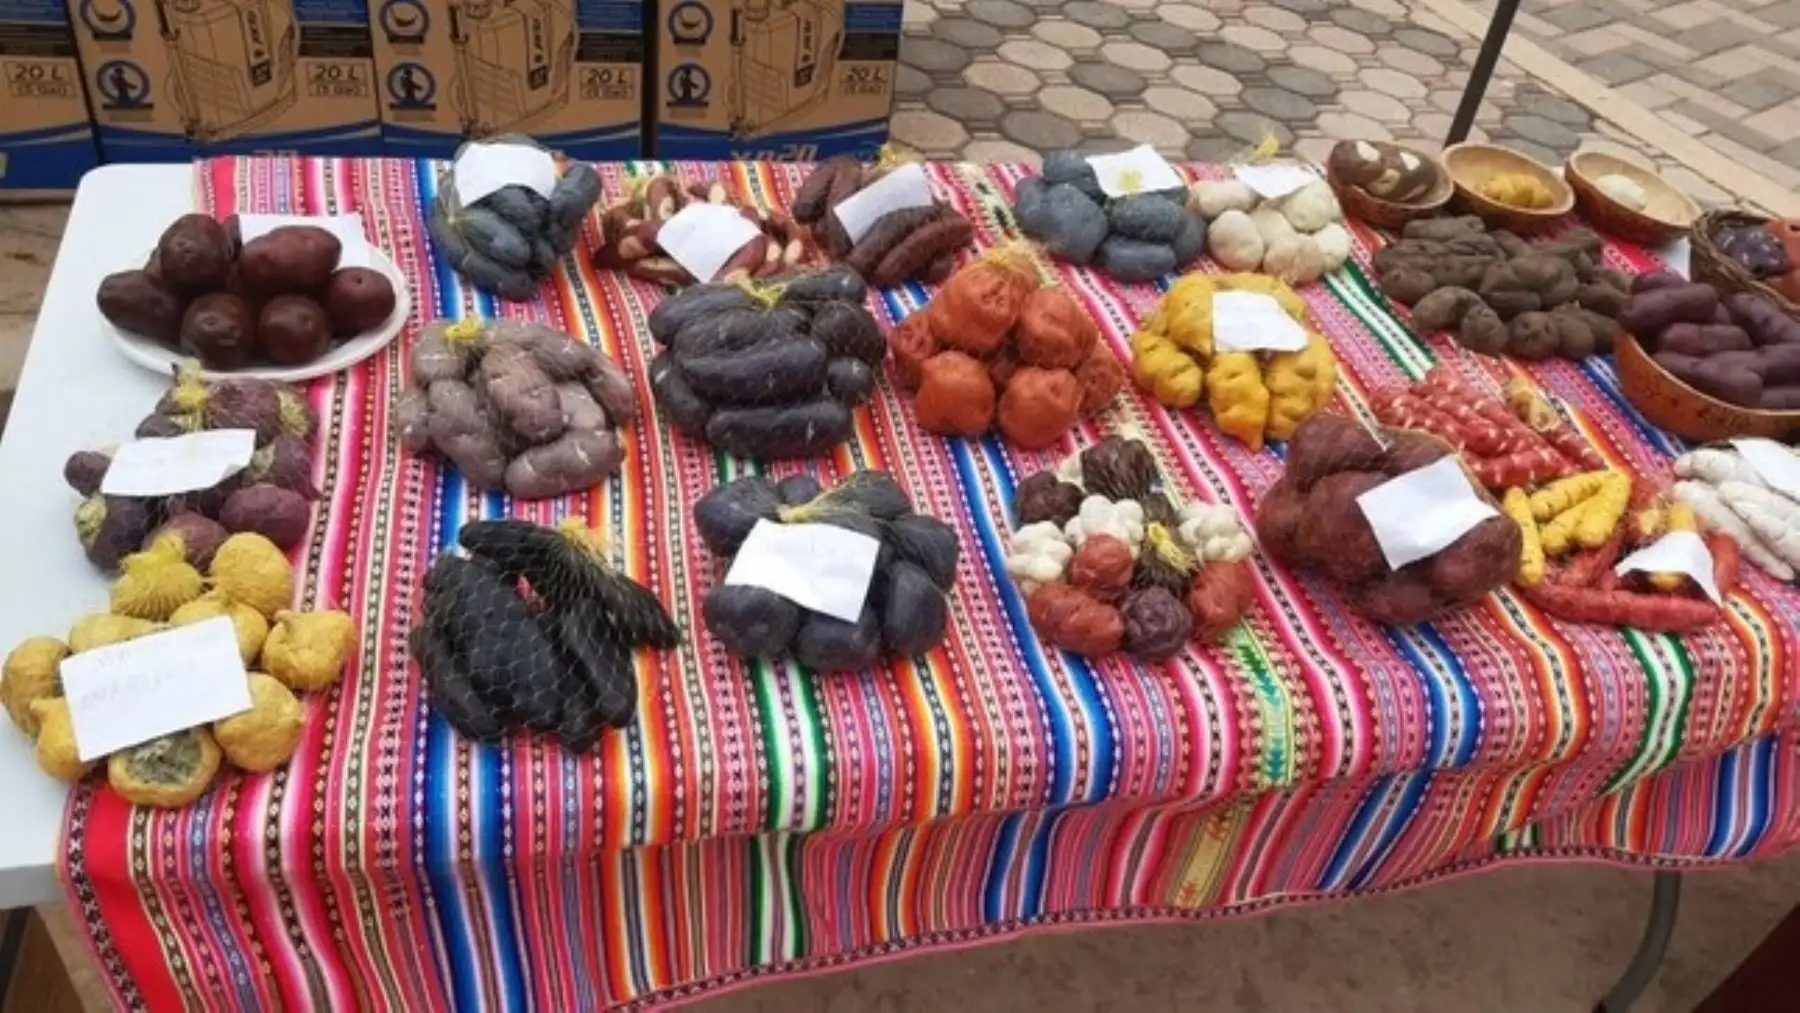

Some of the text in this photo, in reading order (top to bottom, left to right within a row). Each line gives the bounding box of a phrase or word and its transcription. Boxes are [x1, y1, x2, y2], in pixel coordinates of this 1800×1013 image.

[15, 63, 64, 81] 20 L
[315, 64, 359, 80] 20 L
[587, 67, 627, 84] 20 L
[847, 65, 870, 81] 20
